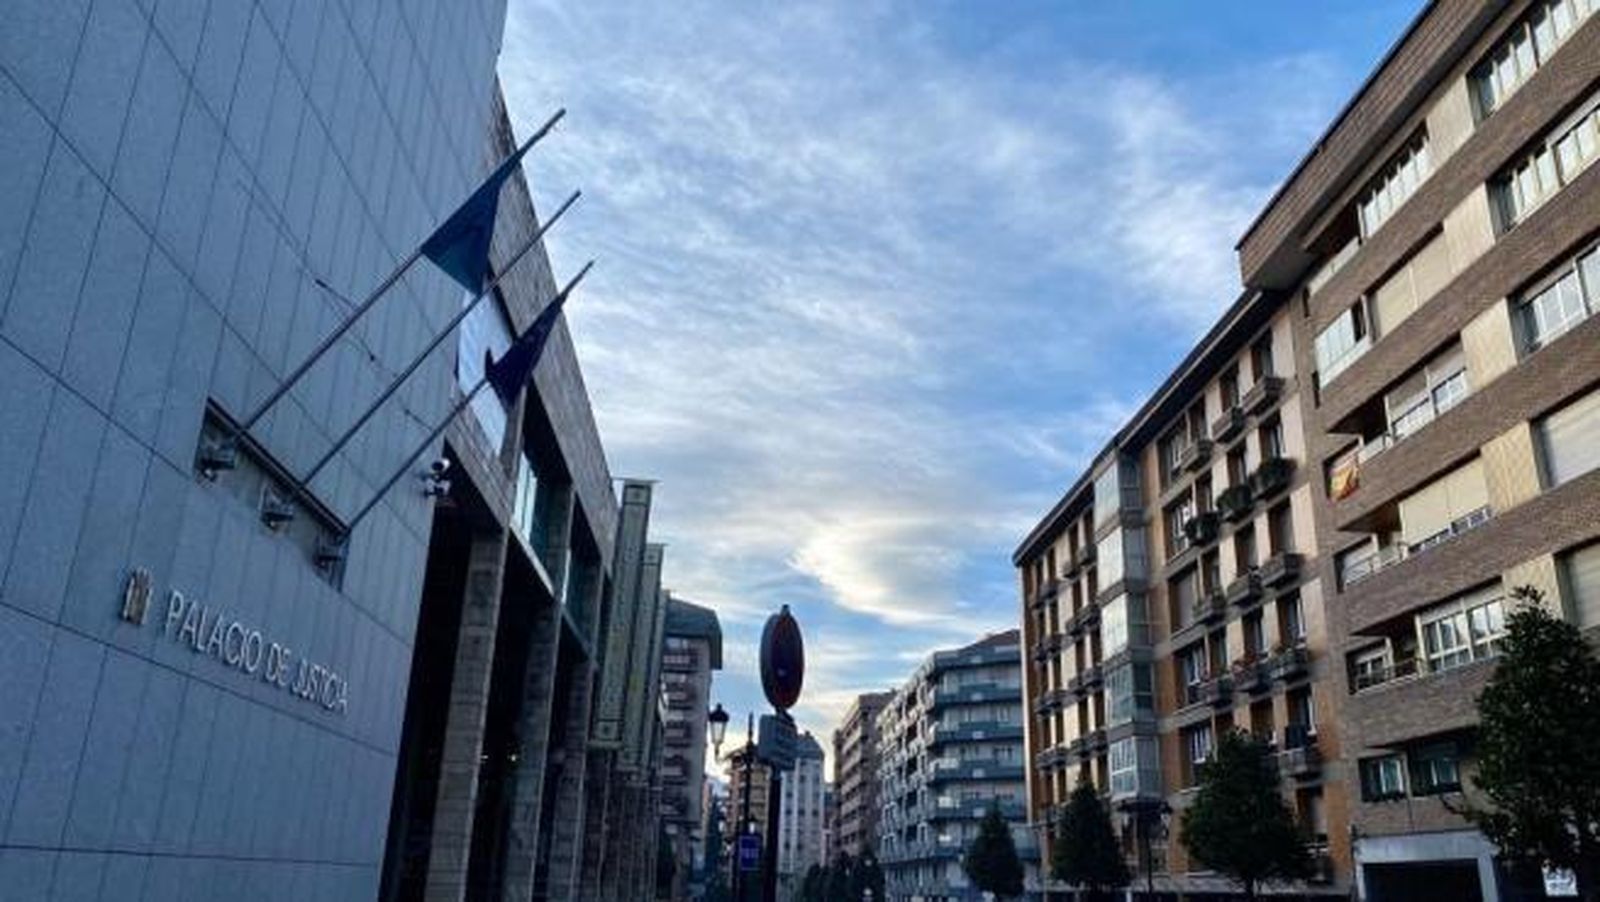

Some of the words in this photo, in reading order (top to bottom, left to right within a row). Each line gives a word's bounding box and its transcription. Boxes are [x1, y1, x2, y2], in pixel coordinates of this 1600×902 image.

[165, 590, 263, 673] PALACIO
[265, 642, 291, 686] DE
[292, 658, 349, 713] JUSTICIA
